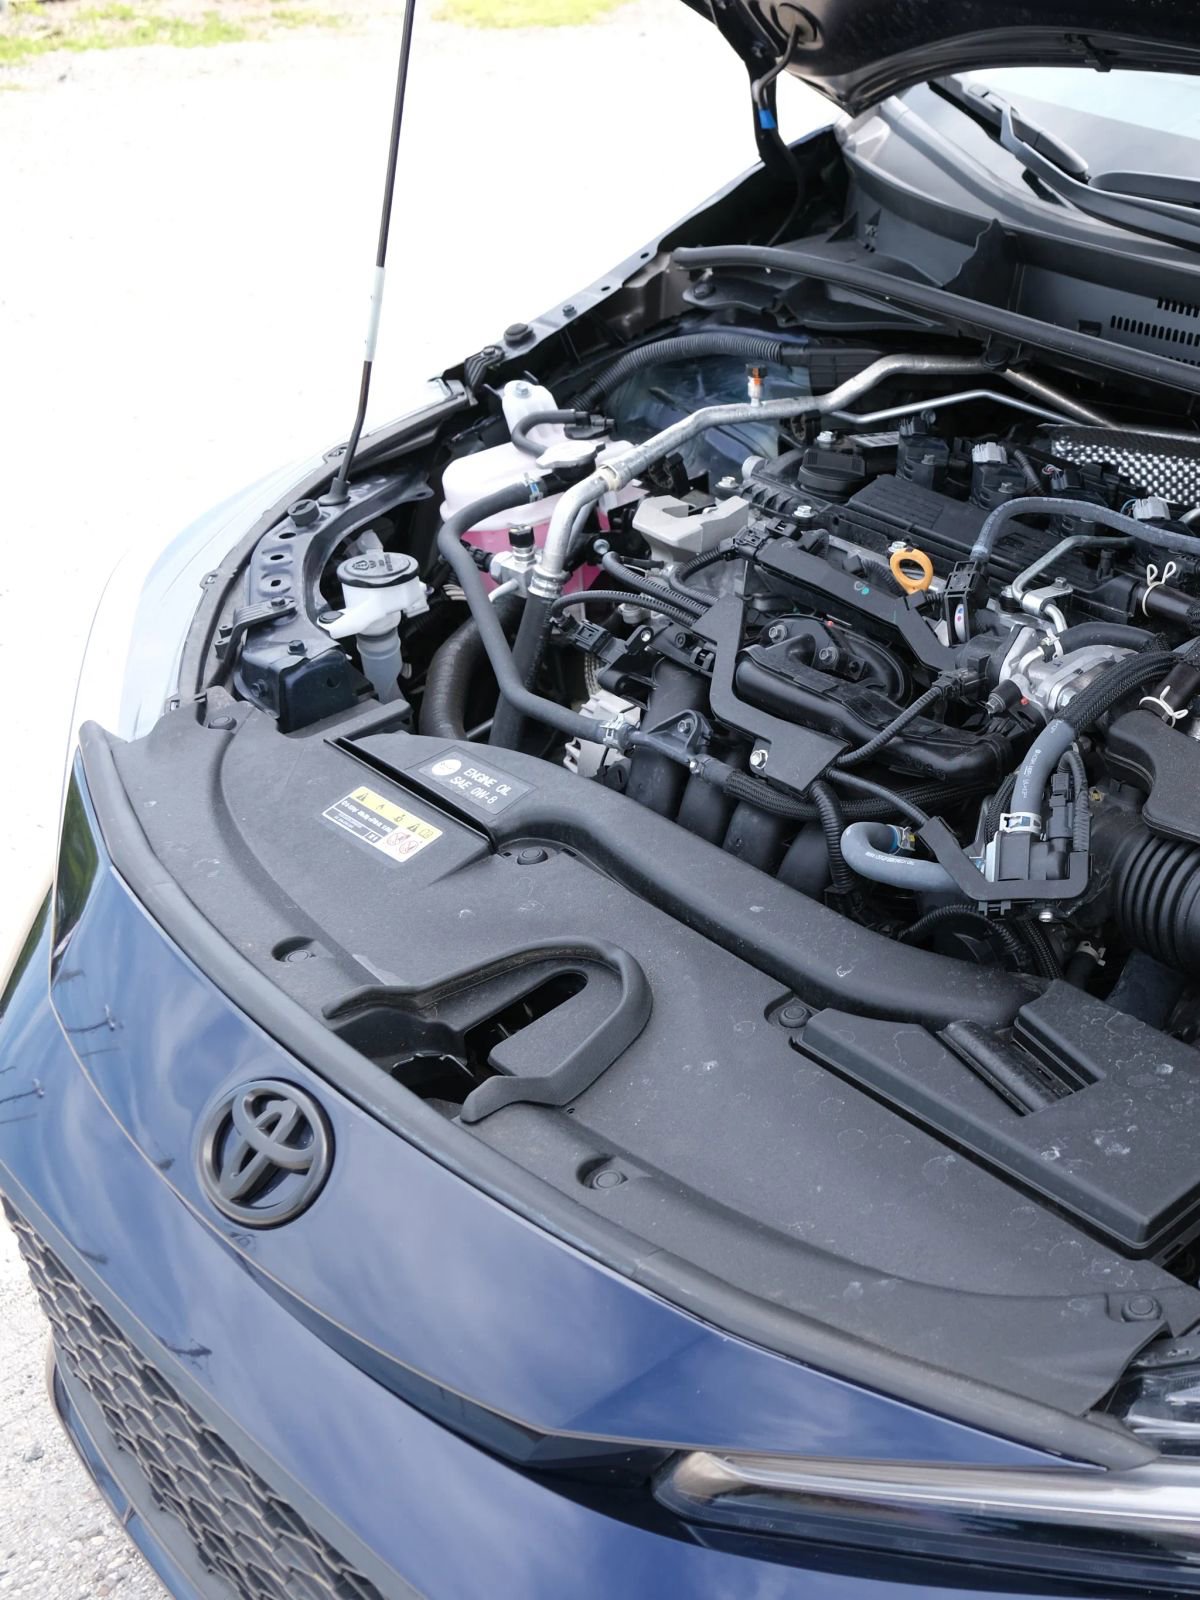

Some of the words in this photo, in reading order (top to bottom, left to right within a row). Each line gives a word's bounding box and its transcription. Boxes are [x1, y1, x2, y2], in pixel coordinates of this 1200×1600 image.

[449, 776, 473, 790] SAE
[470, 787, 498, 804] 0W-8
[463, 767, 498, 788] ENGINE
[495, 783, 512, 796] OIL
